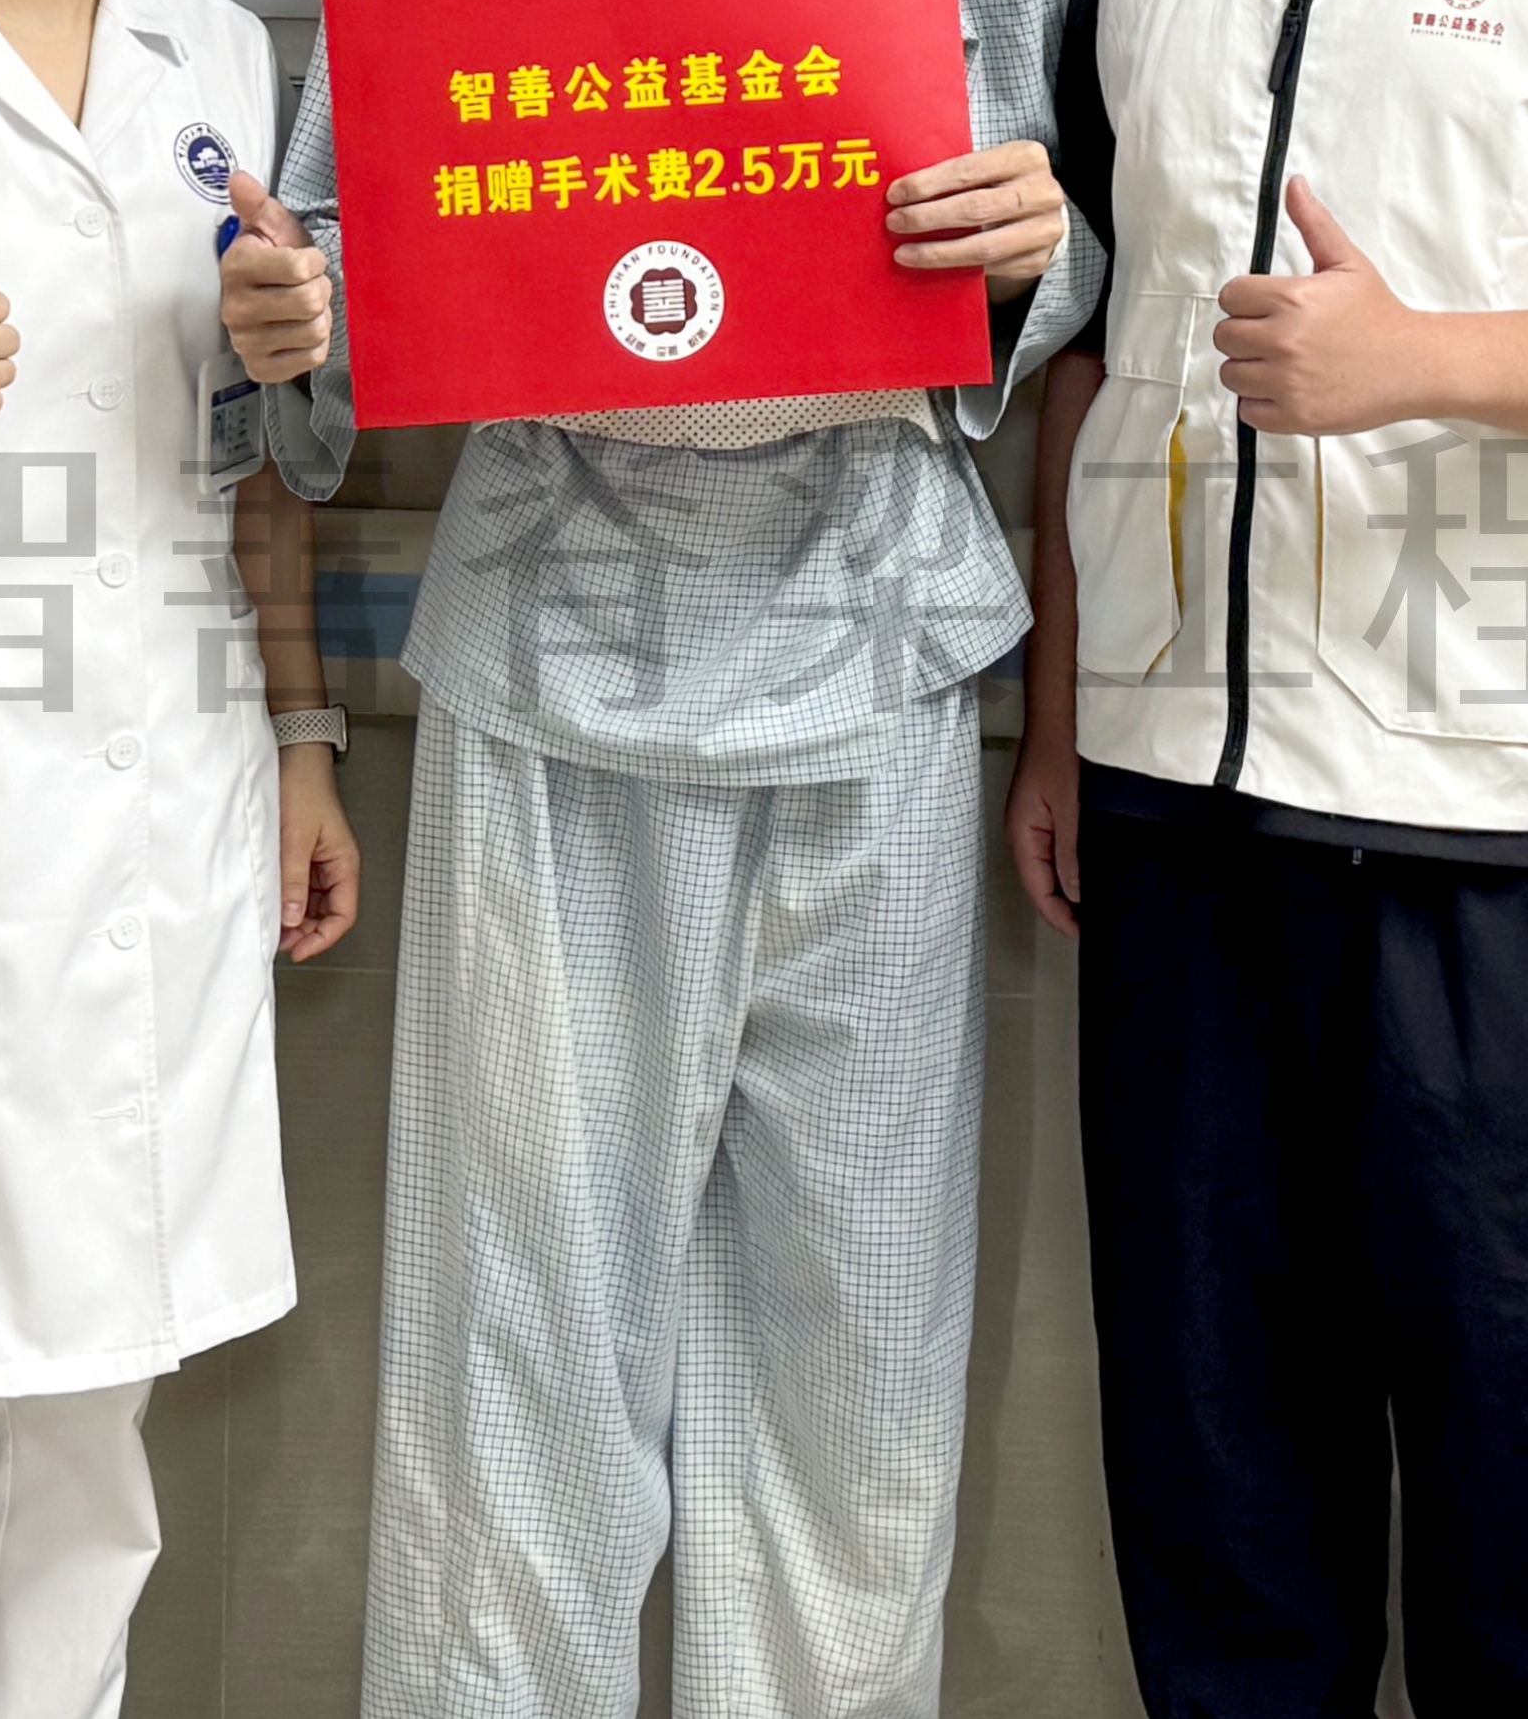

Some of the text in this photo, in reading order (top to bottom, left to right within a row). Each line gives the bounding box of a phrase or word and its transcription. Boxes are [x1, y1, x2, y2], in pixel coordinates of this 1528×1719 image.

[449, 44, 842, 123] 智善公益基金会
[433, 137, 881, 218] 捐赠手术费2.5万元
[608, 244, 721, 319] ZHISHAN FOUNDATION
